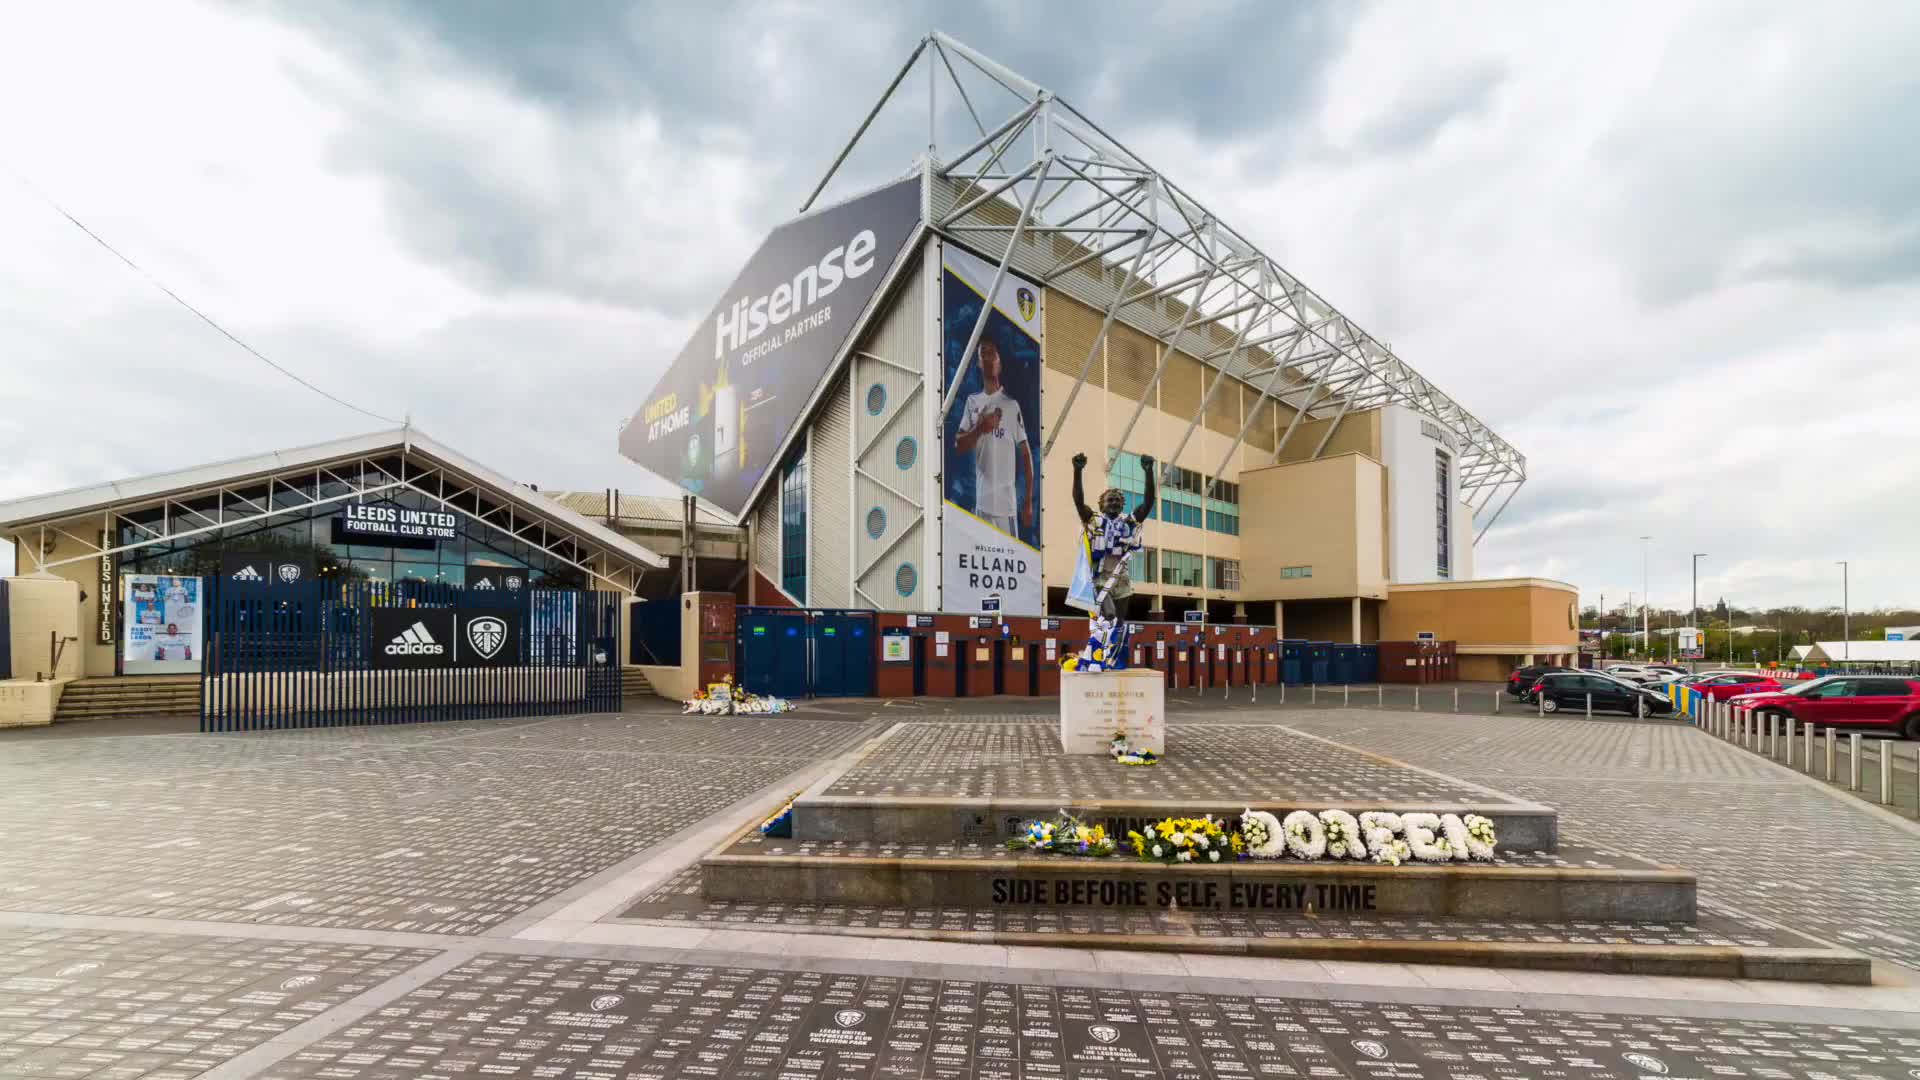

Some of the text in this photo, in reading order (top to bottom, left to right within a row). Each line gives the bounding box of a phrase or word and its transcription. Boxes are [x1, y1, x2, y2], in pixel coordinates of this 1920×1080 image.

[715, 229, 876, 360] Hisense
[742, 306, 831, 366] OFFICIAL PARTNER
[644, 392, 677, 425] UNITED
[648, 405, 690, 443] AT HOME
[347, 505, 455, 527] LEEDS UNITED
[347, 520, 455, 537] FOOTBALL CLUB STORE
[959, 553, 1027, 574] ELLAND
[969, 573, 1018, 590] ROAD
[102, 583, 111, 640] UNITED
[384, 641, 444, 655] adidas
[992, 878, 1377, 910] SIDE BEFORE SELF, EVERY TIME
